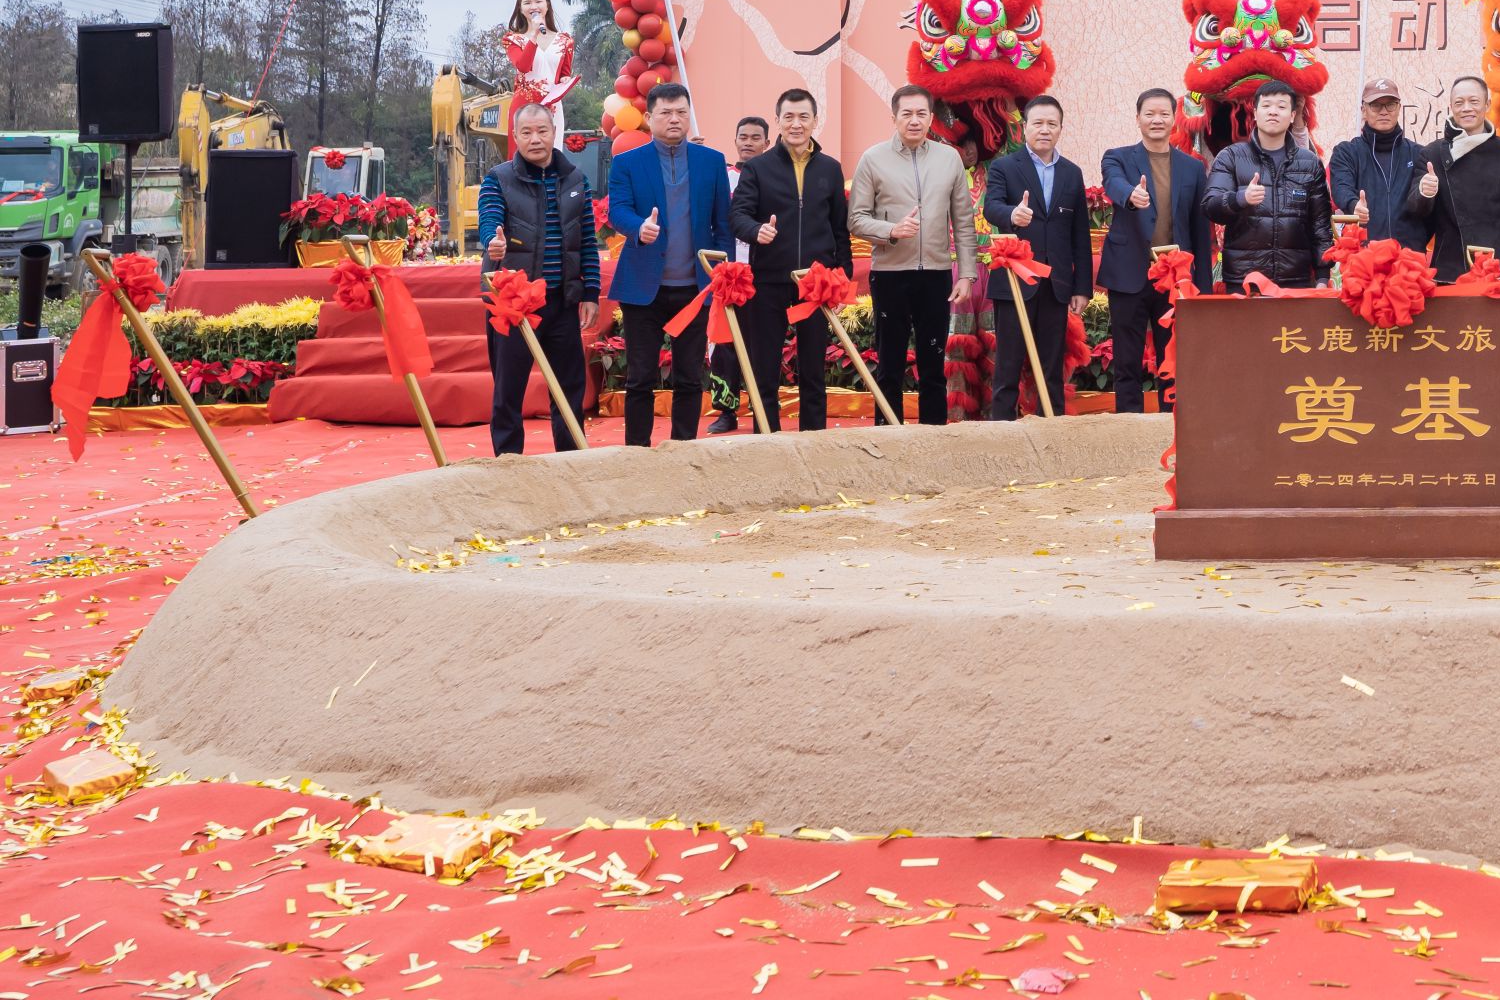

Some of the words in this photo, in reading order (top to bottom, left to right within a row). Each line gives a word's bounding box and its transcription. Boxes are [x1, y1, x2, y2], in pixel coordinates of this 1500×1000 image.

[1272, 325, 1497, 353] 长鹿新文旅
[1277, 376, 1491, 444] 奠基
[1273, 473, 1497, 487] 二零二四年二月二十五日
